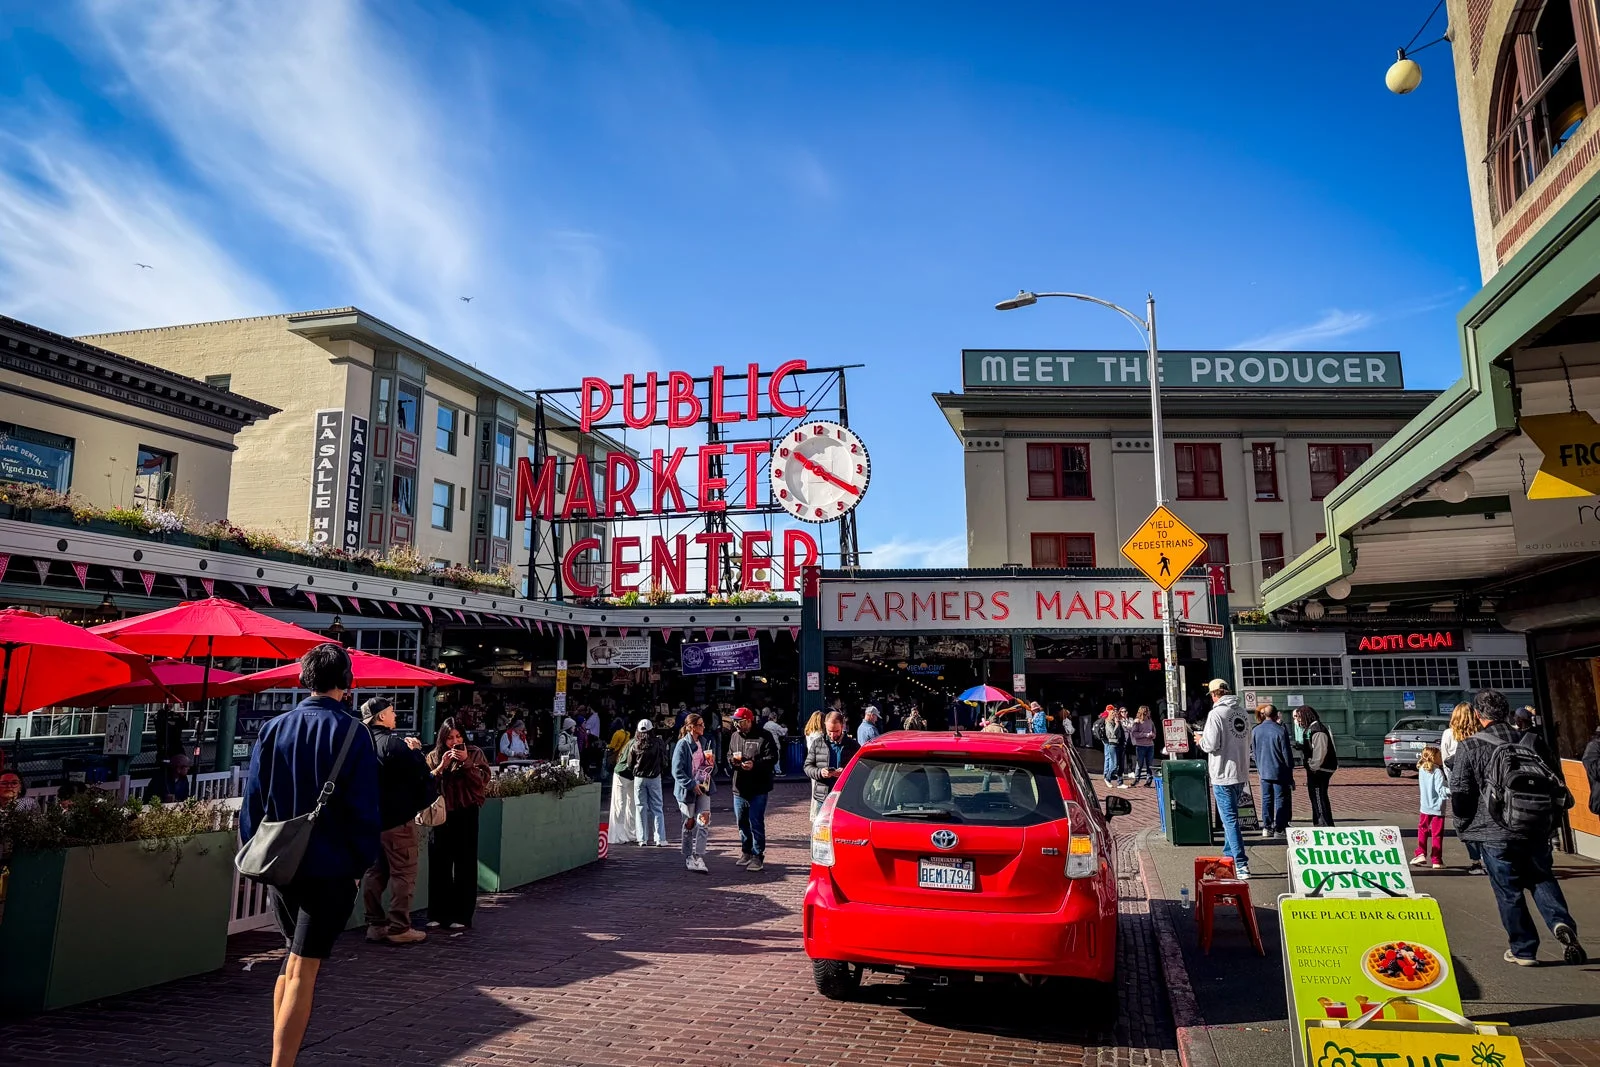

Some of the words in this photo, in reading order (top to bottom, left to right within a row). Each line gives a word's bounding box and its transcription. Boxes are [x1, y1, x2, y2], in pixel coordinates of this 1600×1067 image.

[981, 356, 1075, 382] MEET
[1097, 357, 1164, 382] THE
[1190, 357, 1387, 384] PRODUCER
[579, 359, 808, 434] PUBLIC
[319, 415, 337, 440] LA
[352, 420, 365, 446] LA
[813, 425, 824, 436] 12
[794, 432, 802, 442] 11
[837, 430, 841, 440] 1
[780, 448, 789, 458] 10
[850, 444, 857, 454] 2
[0, 444, 19, 452] LACE
[20, 448, 42, 466] DENTAL
[774, 469, 783, 479] 9
[856, 464, 863, 475] 3
[316, 444, 336, 509] SALLE
[515, 441, 772, 522] MARKET
[348, 451, 363, 514] SALLE
[780, 489, 788, 500] 8
[795, 504, 803, 513] 7
[837, 502, 844, 511] 5
[815, 508, 823, 518] 6
[1149, 520, 1175, 529] YIELD
[1157, 530, 1168, 539] TO
[1132, 538, 1194, 550] PEDESTRIANS
[837, 591, 1010, 622] FARMERS
[1035, 590, 1196, 621] MARKET
[1359, 634, 1404, 651] ADITI
[1407, 631, 1453, 648] CHAI
[1312, 829, 1377, 846] Fresh
[1295, 847, 1402, 865] Shucked
[921, 868, 971, 885] BEM1794
[1302, 868, 1406, 891] Oysters
[1291, 911, 1318, 920] PIKE
[1320, 911, 1357, 920] PLACE
[1360, 911, 1384, 920] BAR
[1386, 911, 1396, 920] &
[1398, 911, 1435, 921] GRILL
[1296, 945, 1349, 955] BREAKFAST
[1298, 959, 1341, 968] BRUNCH
[1300, 975, 1352, 985] EVERYDAY
